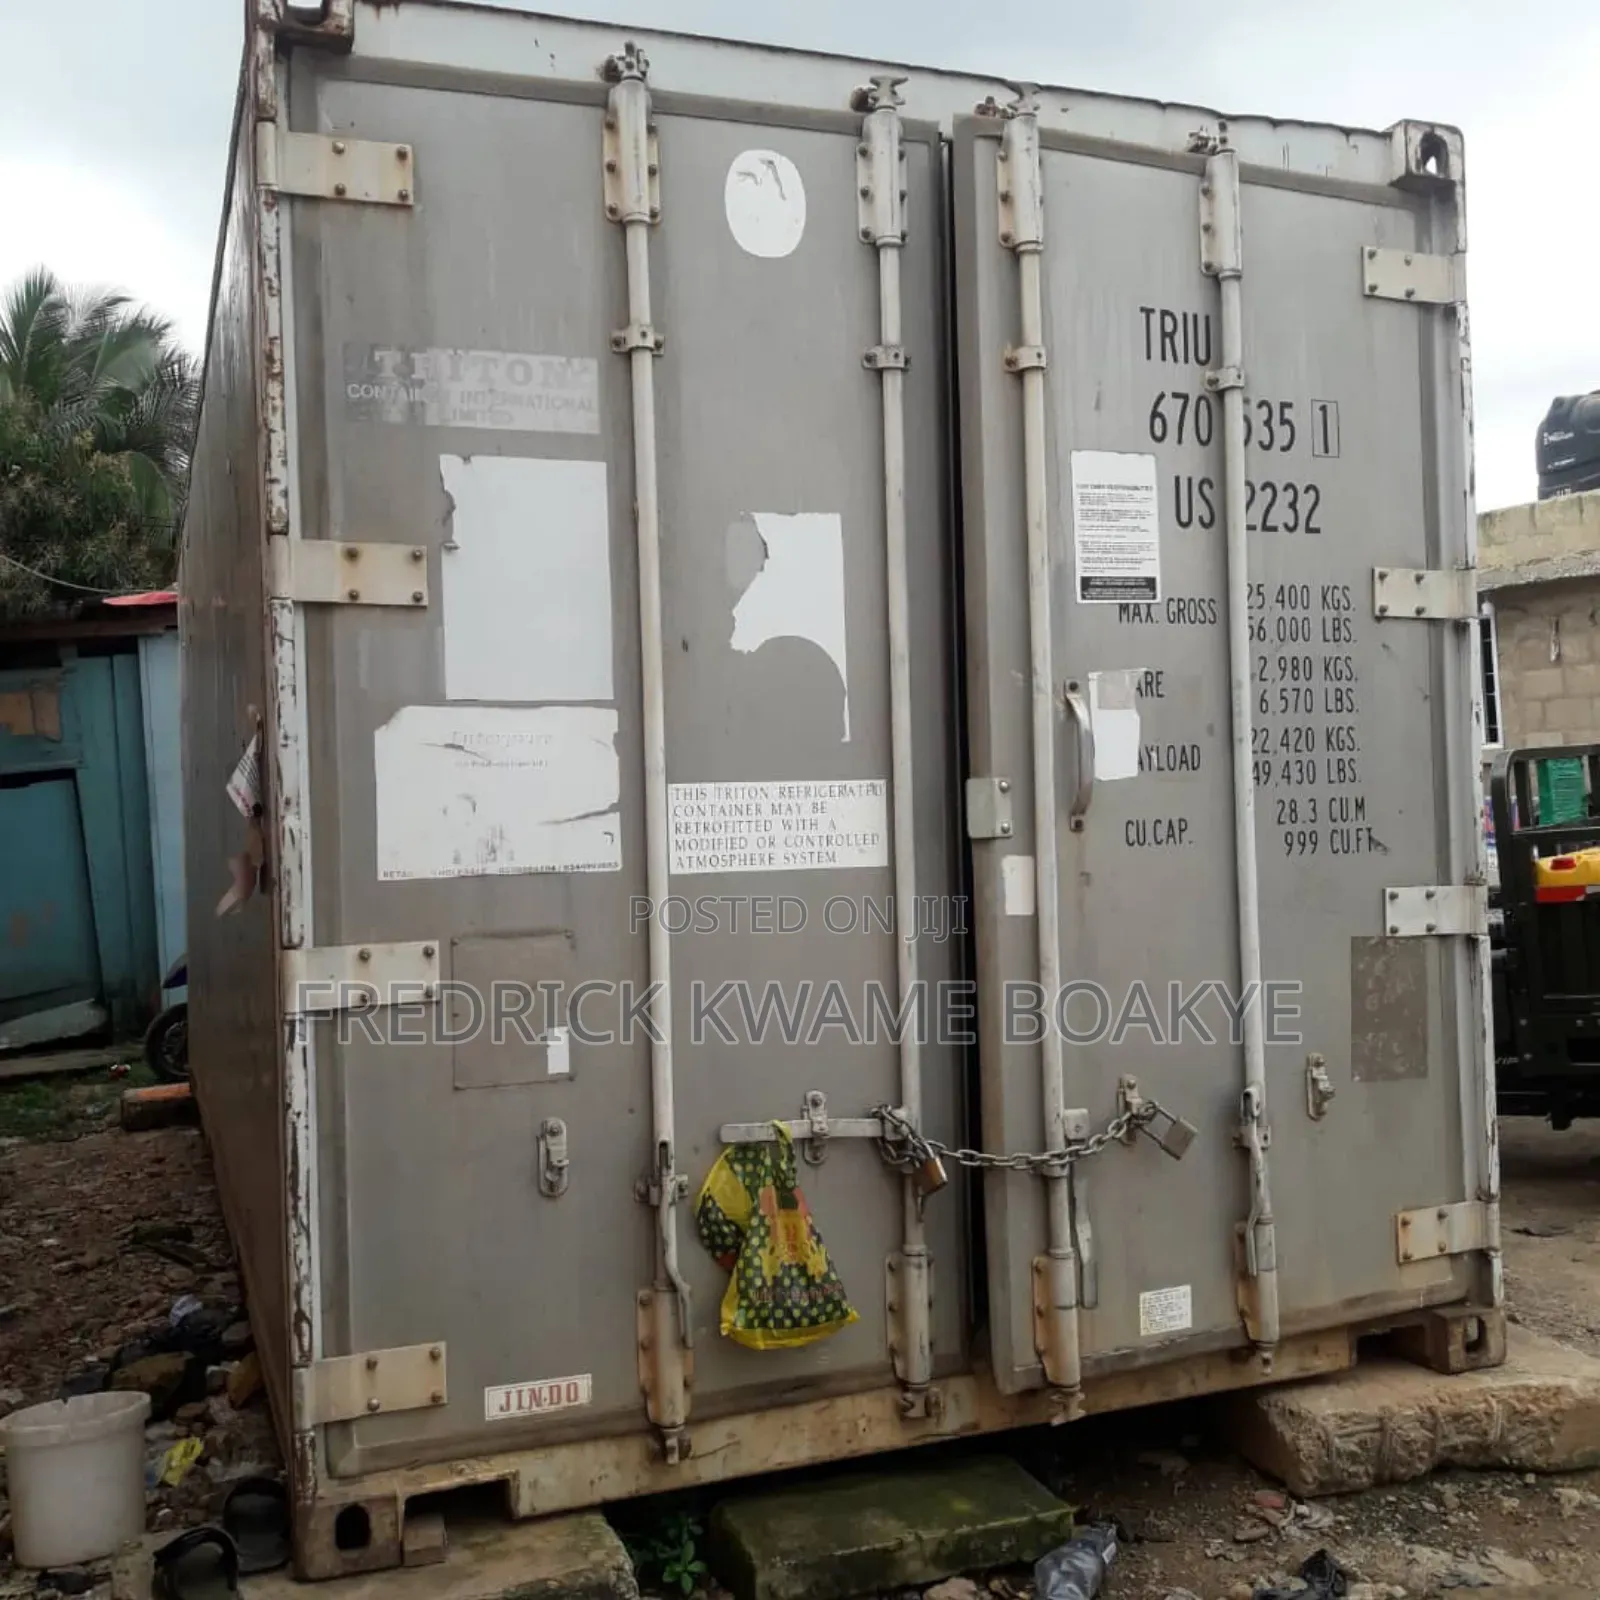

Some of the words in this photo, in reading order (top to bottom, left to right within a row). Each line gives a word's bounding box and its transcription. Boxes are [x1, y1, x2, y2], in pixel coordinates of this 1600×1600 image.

[1139, 306, 1211, 366] TRIU
[1150, 391, 1213, 446] 670
[1317, 403, 1331, 455] 1
[1174, 475, 1215, 529] US
[1245, 480, 1321, 534] 2232
[1118, 602, 1159, 624] MAX.
[1166, 598, 1217, 625] GROSS
[1321, 585, 1356, 612] KGS.
[1322, 616, 1358, 643] LBS.
[1136, 671, 1165, 698] ARE
[1324, 656, 1358, 684] KGS.
[1324, 687, 1359, 713] LBS.
[1138, 744, 1201, 772] AYLOAD
[1326, 726, 1361, 752] KGS.
[1327, 758, 1362, 784] LBS.
[675, 787, 708, 801] THIS
[716, 786, 769, 800] TRITON
[673, 803, 763, 818] CONTAINER
[771, 802, 801, 816] MAY
[811, 801, 828, 814] BE
[1277, 798, 1317, 825] 28.3
[675, 819, 773, 835] RETROFITTED
[781, 818, 819, 832] WITH
[828, 818, 837, 831] A
[675, 836, 748, 852] MODIFIED
[756, 836, 776, 849] OR
[784, 833, 880, 848] CONTROLLED
[1284, 830, 1318, 856] 999
[675, 852, 775, 870] ATMOSPHERE
[783, 850, 837, 865] SYSTEM
[499, 1382, 580, 1413] JINDO
